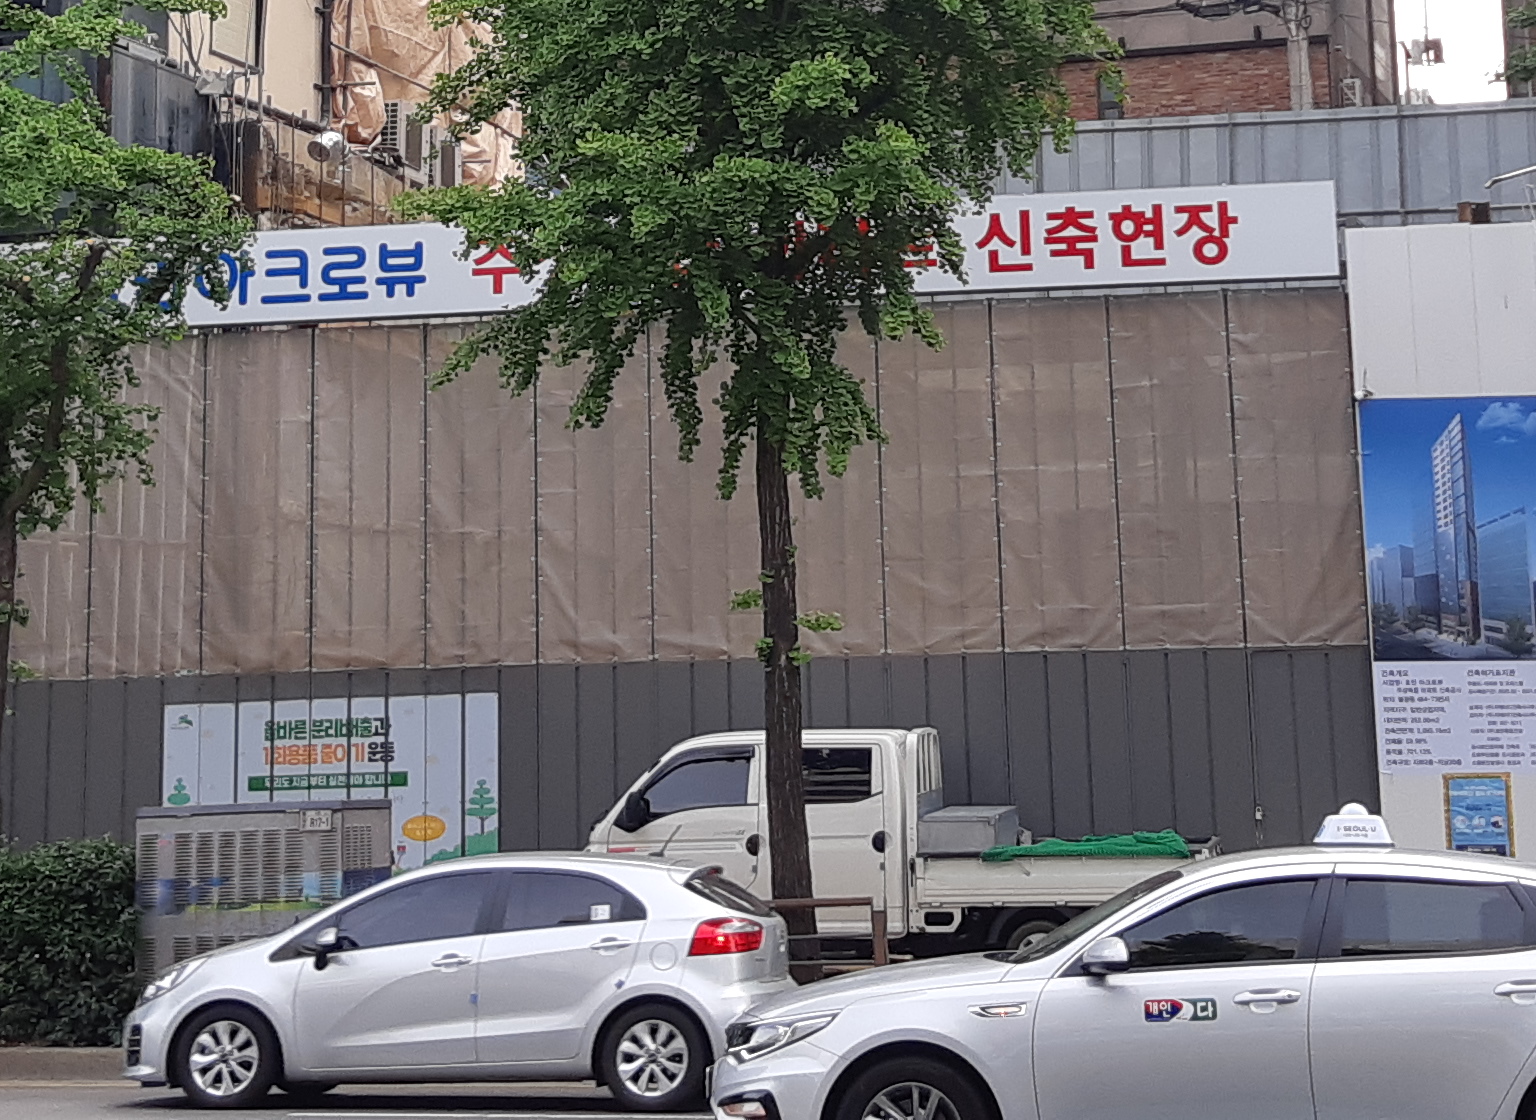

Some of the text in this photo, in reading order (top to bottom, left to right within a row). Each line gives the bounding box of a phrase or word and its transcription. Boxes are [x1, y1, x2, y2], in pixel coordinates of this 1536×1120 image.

[975, 200, 1239, 273] 신축현장
[194, 240, 427, 306] 아크로뷰
[264, 719, 308, 742] 올바른
[320, 741, 366, 765] 줄이기
[367, 740, 396, 763] 운동
[1146, 1000, 1214, 1018] 개인 다
